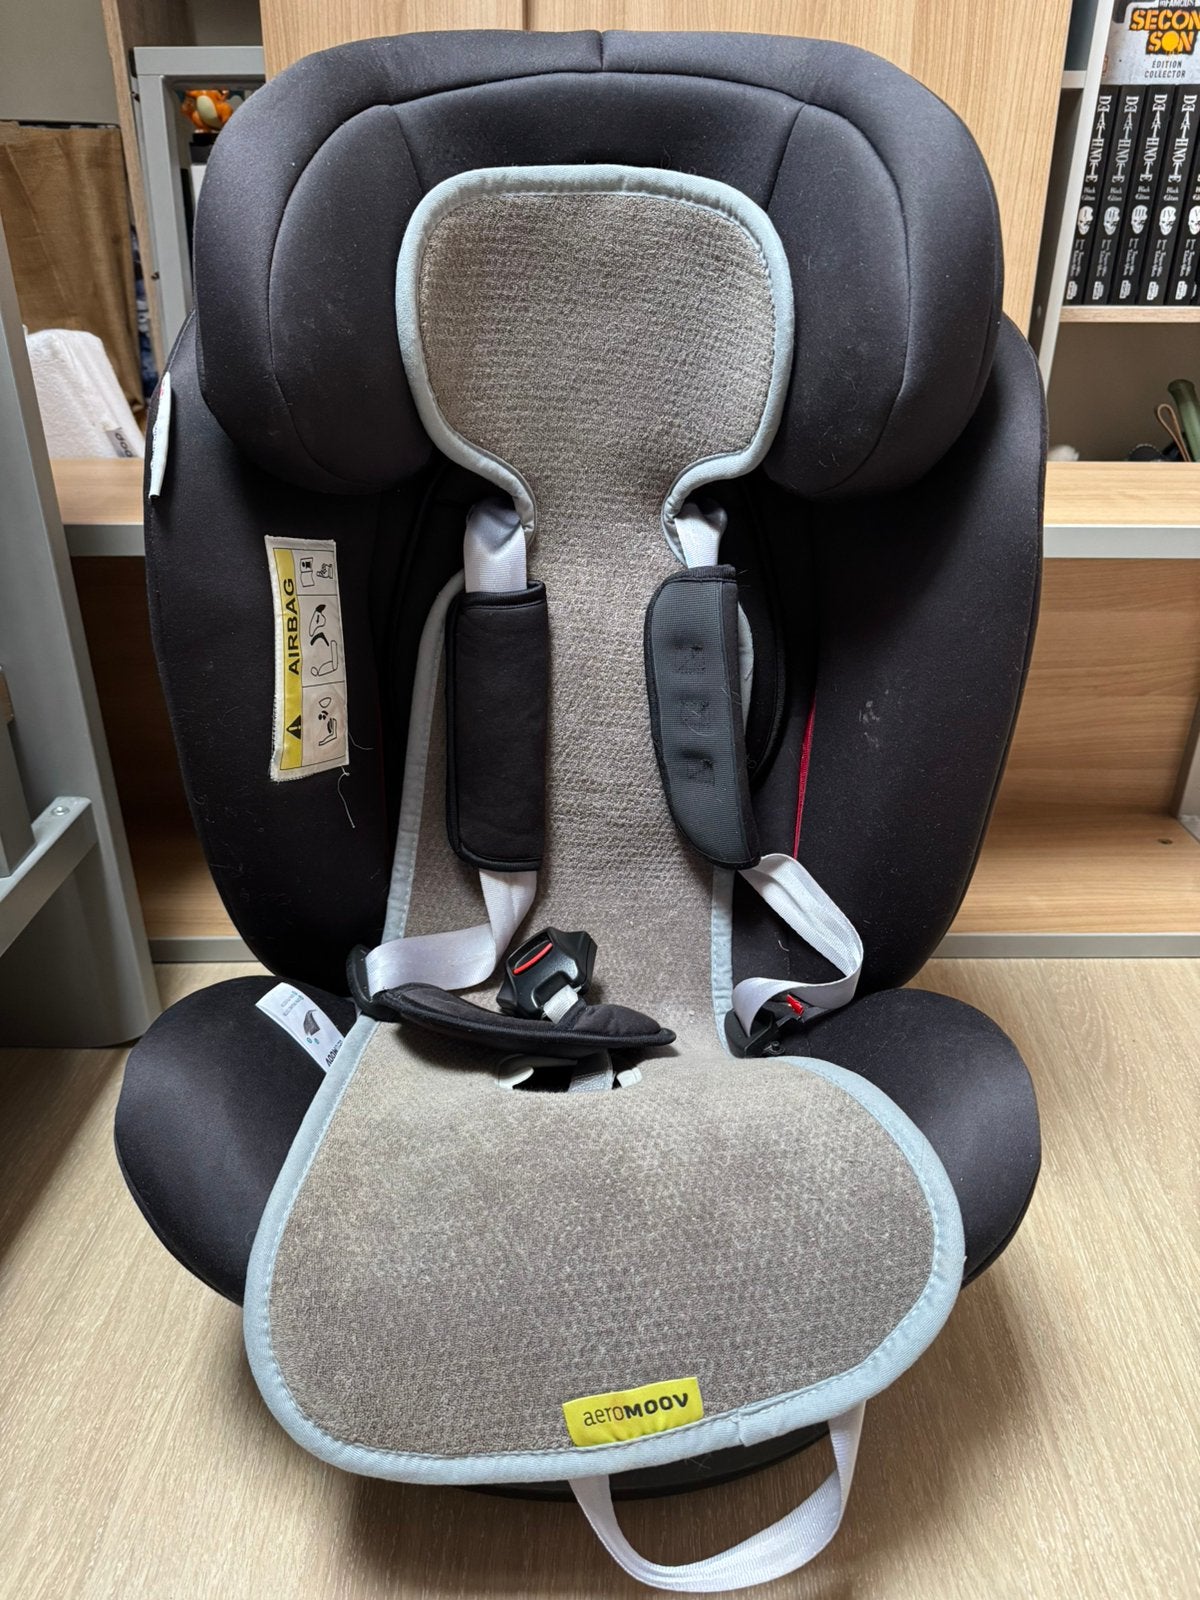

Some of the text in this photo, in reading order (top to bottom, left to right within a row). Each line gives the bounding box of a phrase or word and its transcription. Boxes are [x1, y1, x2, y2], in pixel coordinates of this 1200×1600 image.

[1148, 30, 1194, 52] SON
[1144, 70, 1186, 78] COLLECTOR
[283, 578, 300, 675] AIRBAG
[583, 1393, 688, 1427] aeroMOOV
